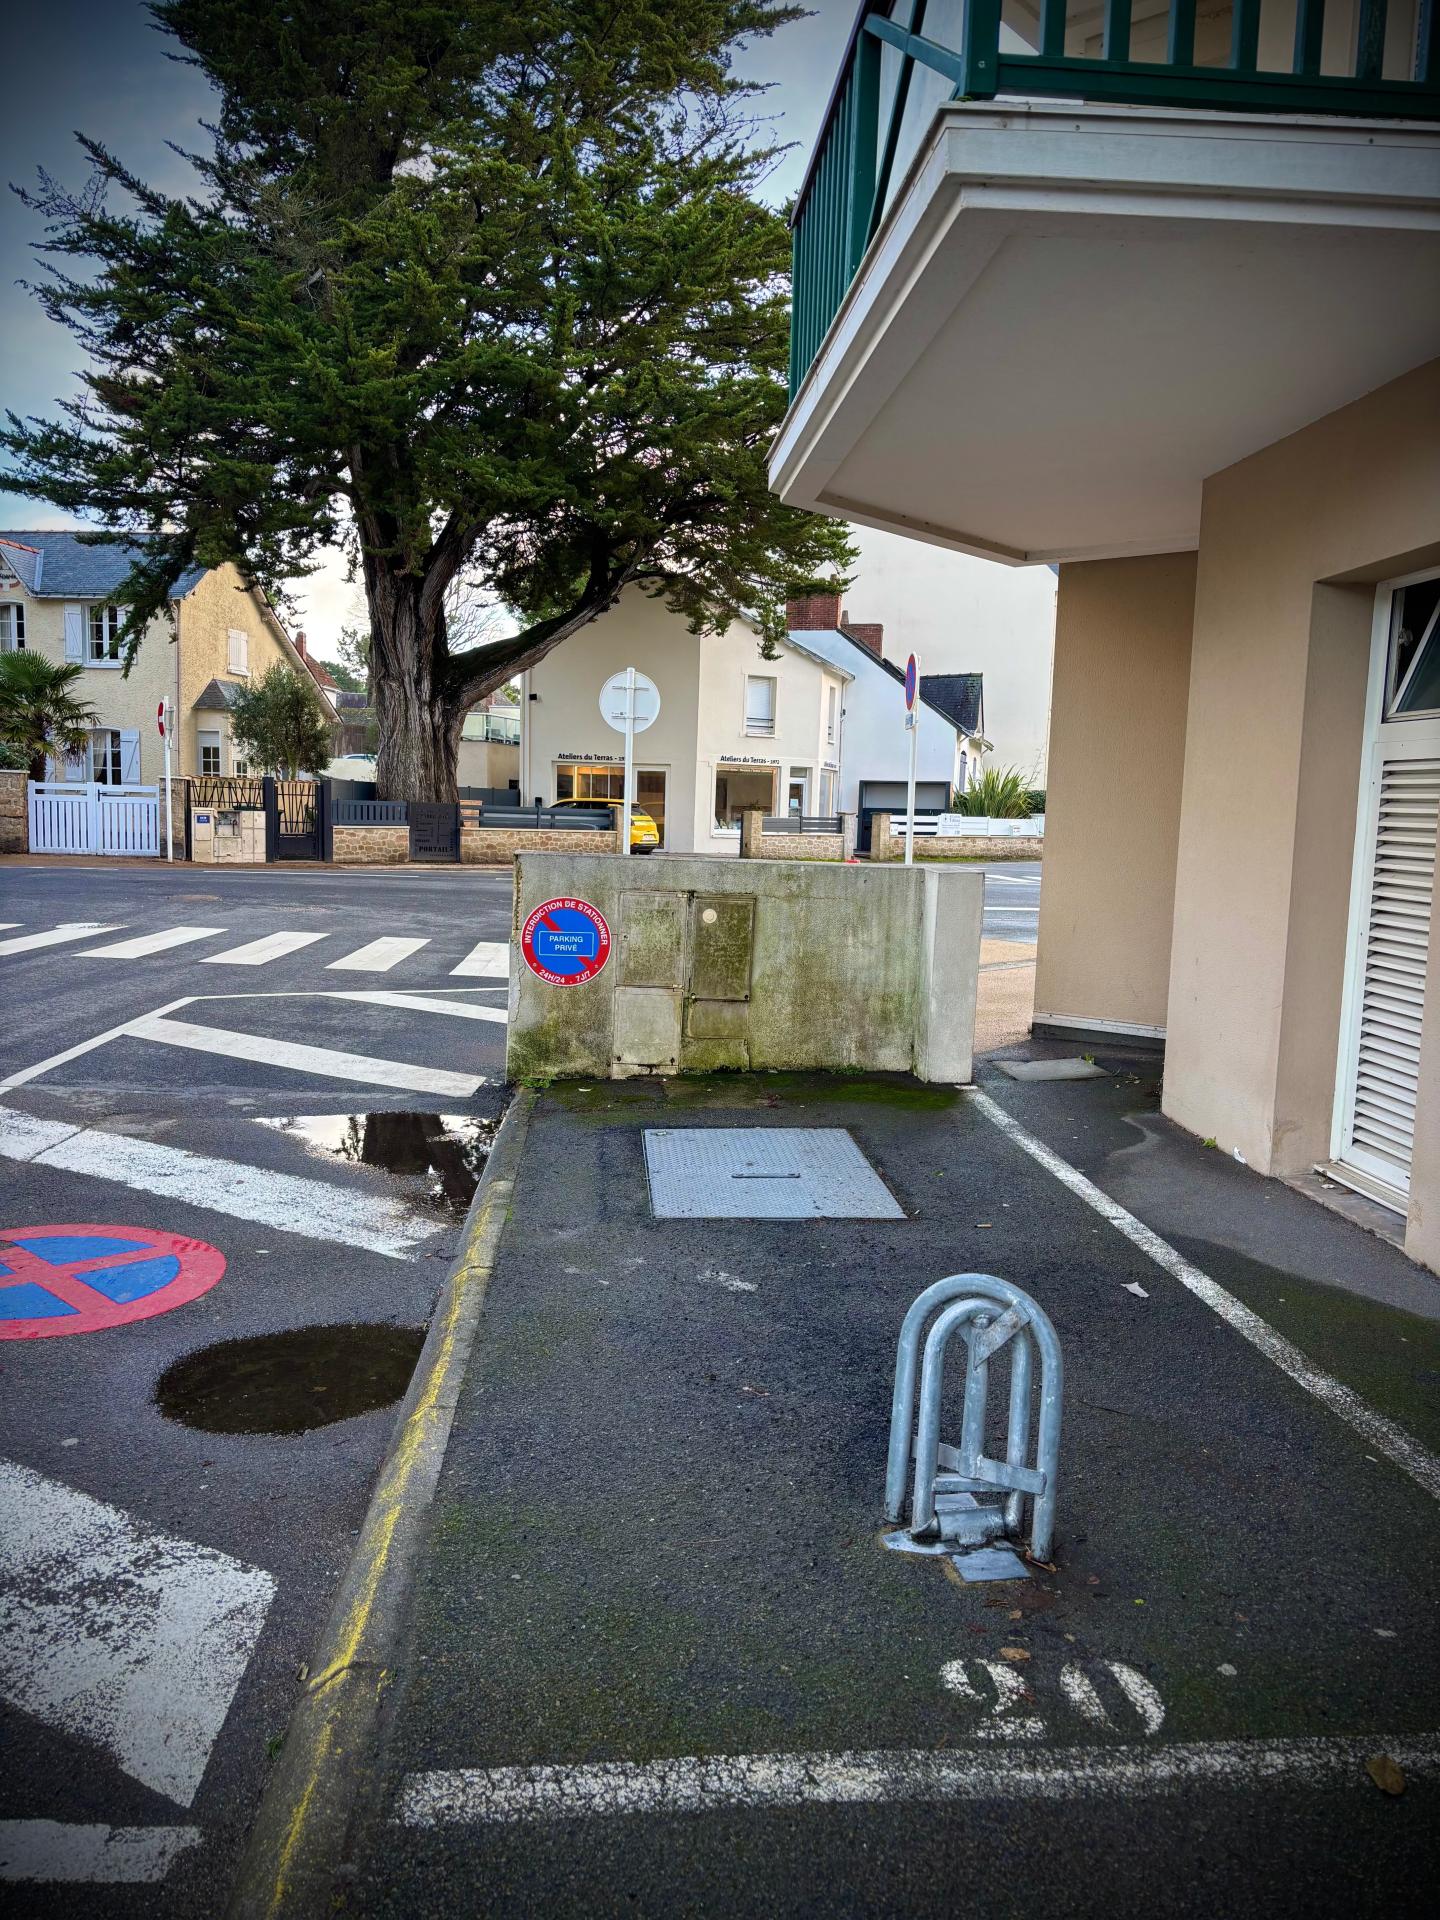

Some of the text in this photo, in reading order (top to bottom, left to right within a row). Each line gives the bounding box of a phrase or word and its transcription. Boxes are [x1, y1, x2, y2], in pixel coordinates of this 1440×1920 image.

[558, 753, 582, 761] Ateliers
[751, 756, 766, 764] Terras
[525, 901, 563, 944] INTERDICTION
[578, 904, 608, 946] STATIONNER
[549, 935, 584, 943] PARKING
[554, 943, 578, 952] PRIVÉ
[539, 969, 565, 984] 24H/24
